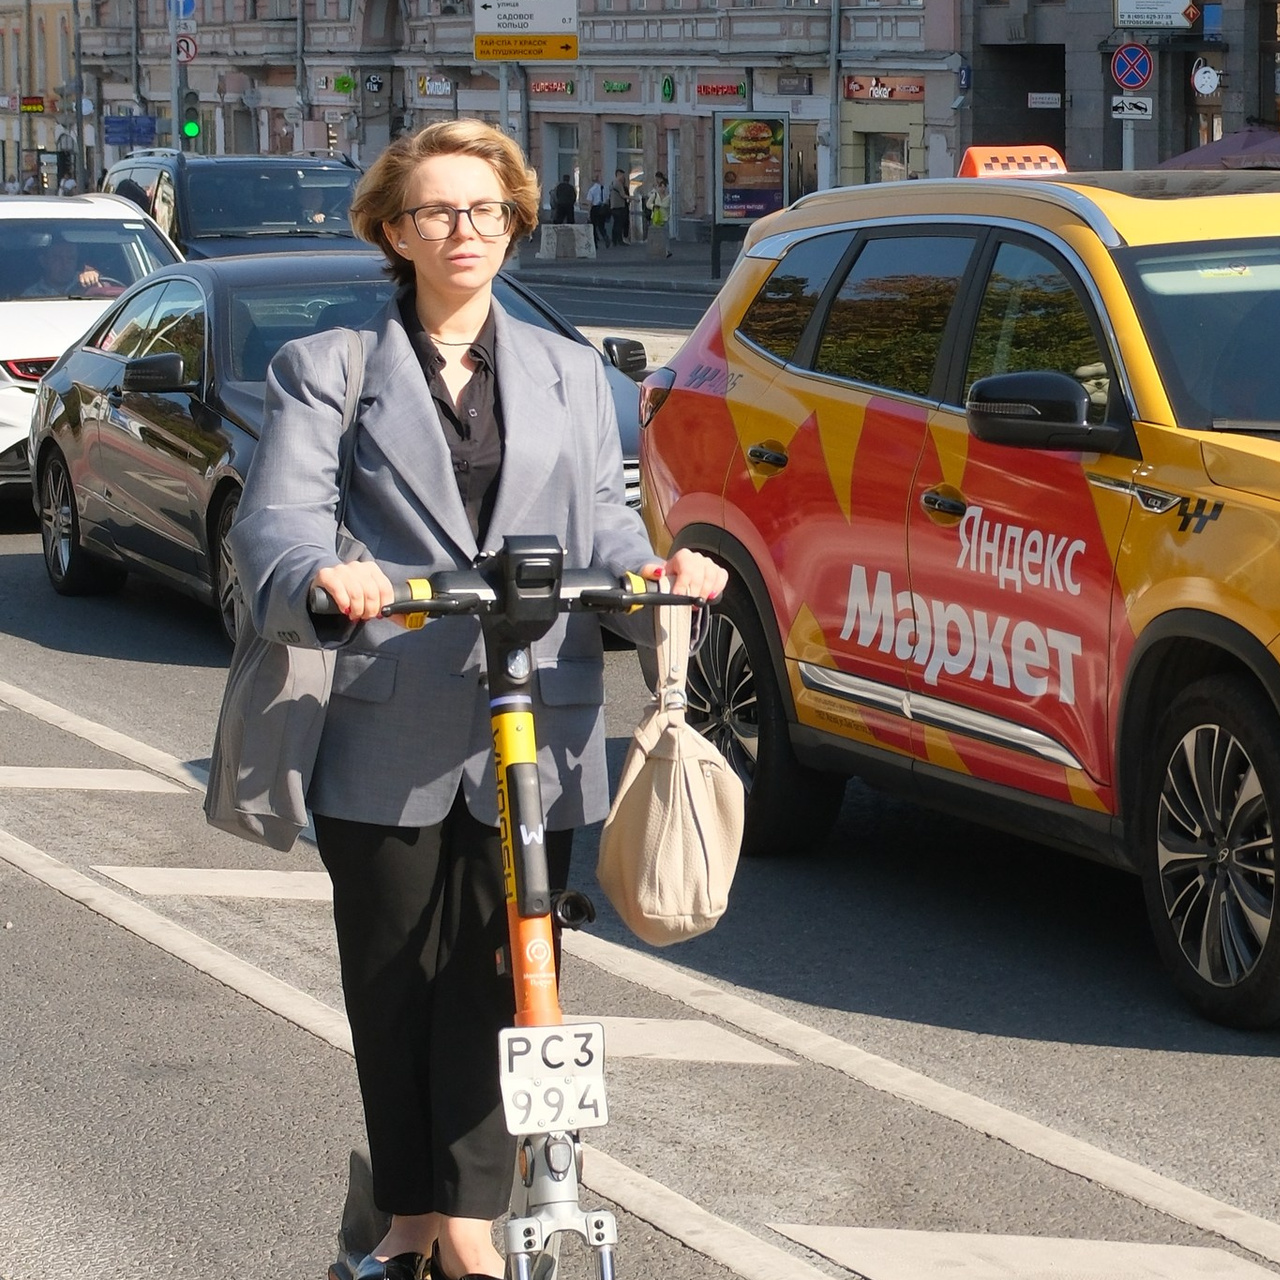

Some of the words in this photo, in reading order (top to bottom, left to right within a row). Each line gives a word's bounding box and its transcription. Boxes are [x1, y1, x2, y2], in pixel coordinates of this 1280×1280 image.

[956, 505, 1086, 596] Яндекс
[839, 564, 1082, 705] Маркет
[511, 1084, 599, 1125] 994
